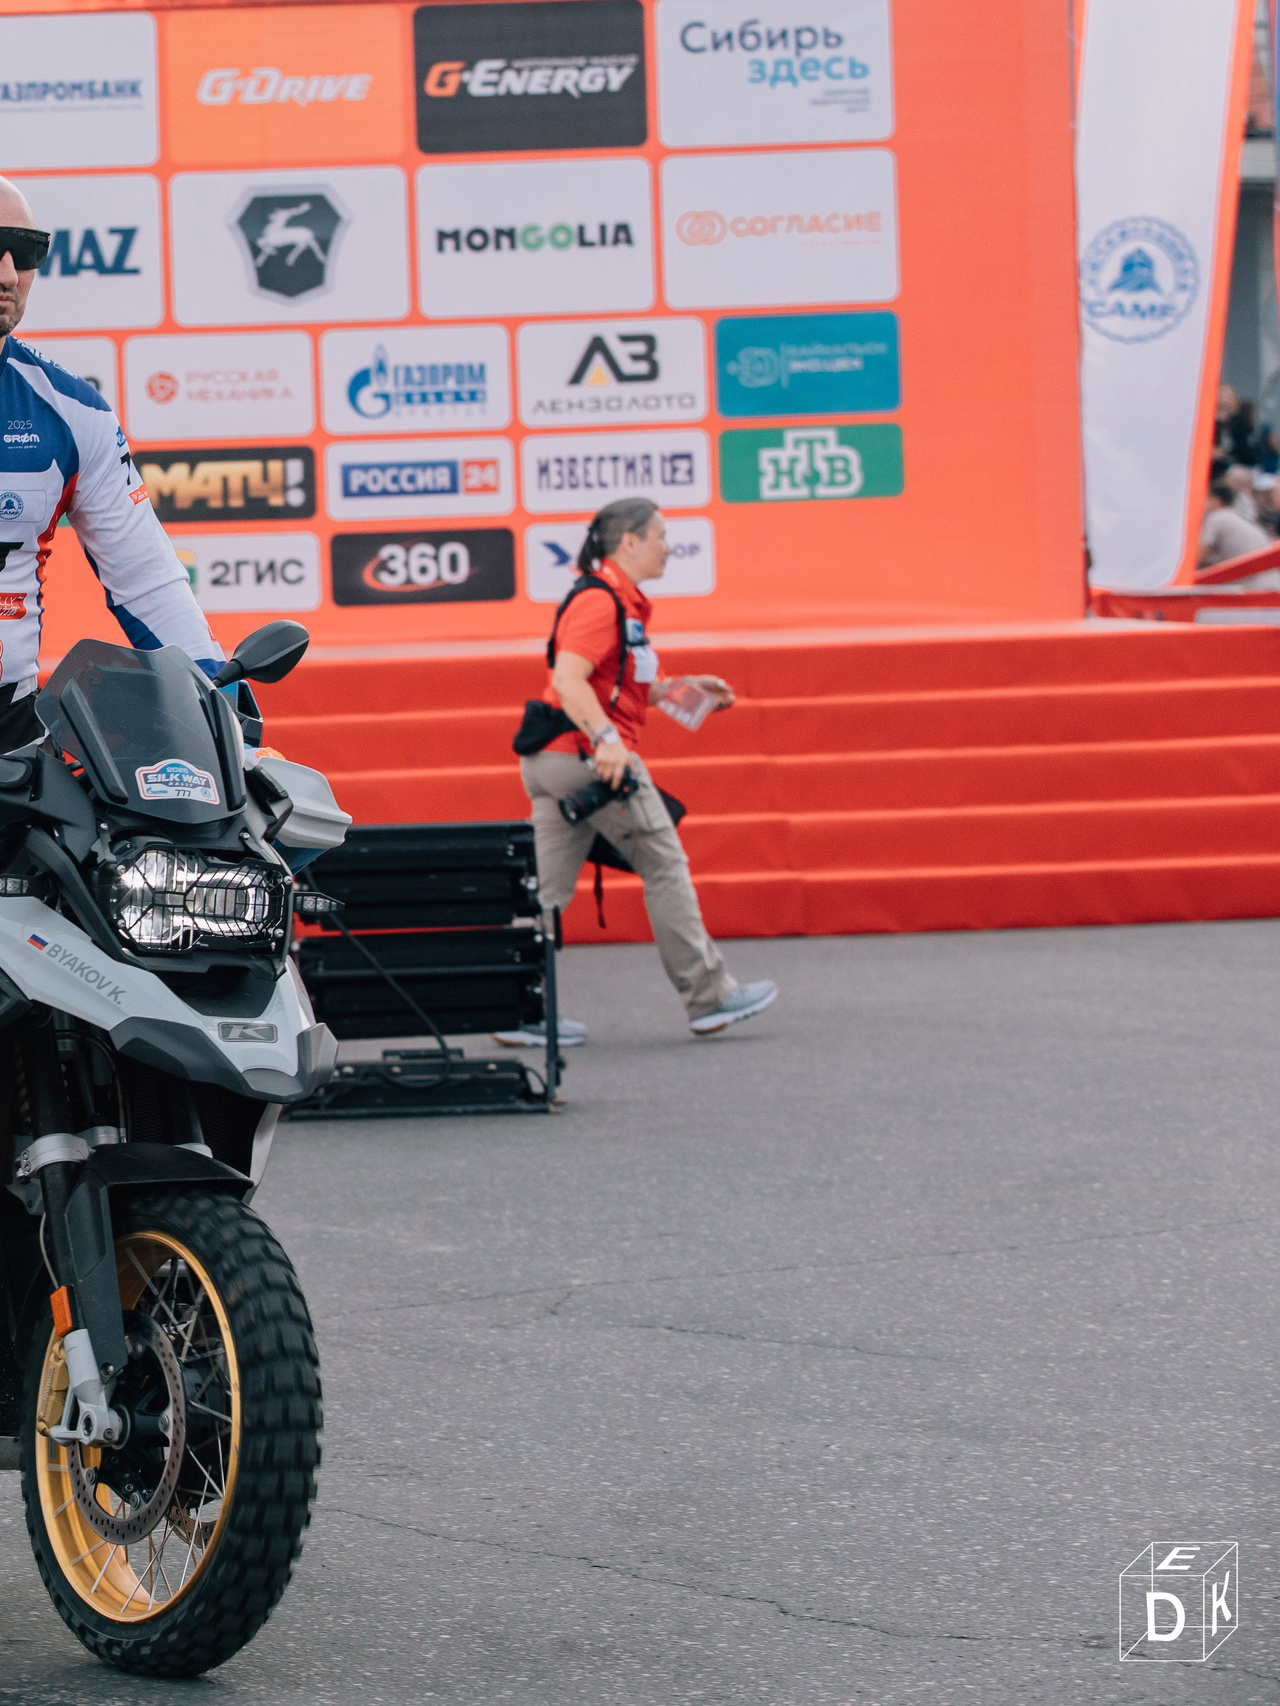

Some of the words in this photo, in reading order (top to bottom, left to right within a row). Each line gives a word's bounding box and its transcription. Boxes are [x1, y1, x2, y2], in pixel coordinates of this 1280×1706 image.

[680, 19, 844, 57] Сибирь
[746, 56, 870, 89] здесь
[436, 222, 635, 254] MONGOLIA
[730, 211, 883, 239] СОГЛАСИЕ
[393, 361, 487, 387] ГАЗПРОМ
[7, 419, 33, 430] 2025
[349, 464, 452, 494] РОССИЯ
[465, 463, 497, 490] 24
[536, 452, 653, 491] ИЗВЕСТИЯ
[760, 429, 863, 499] НТВ
[141, 458, 306, 509] МАТЧ!
[210, 559, 305, 587] 2ГИС
[377, 541, 471, 587] 360
[146, 773, 180, 783] SILK
[182, 774, 208, 786] WAY
[174, 789, 192, 798] 777
[46, 943, 113, 990] BYAKOV
[107, 985, 126, 1005] K.
